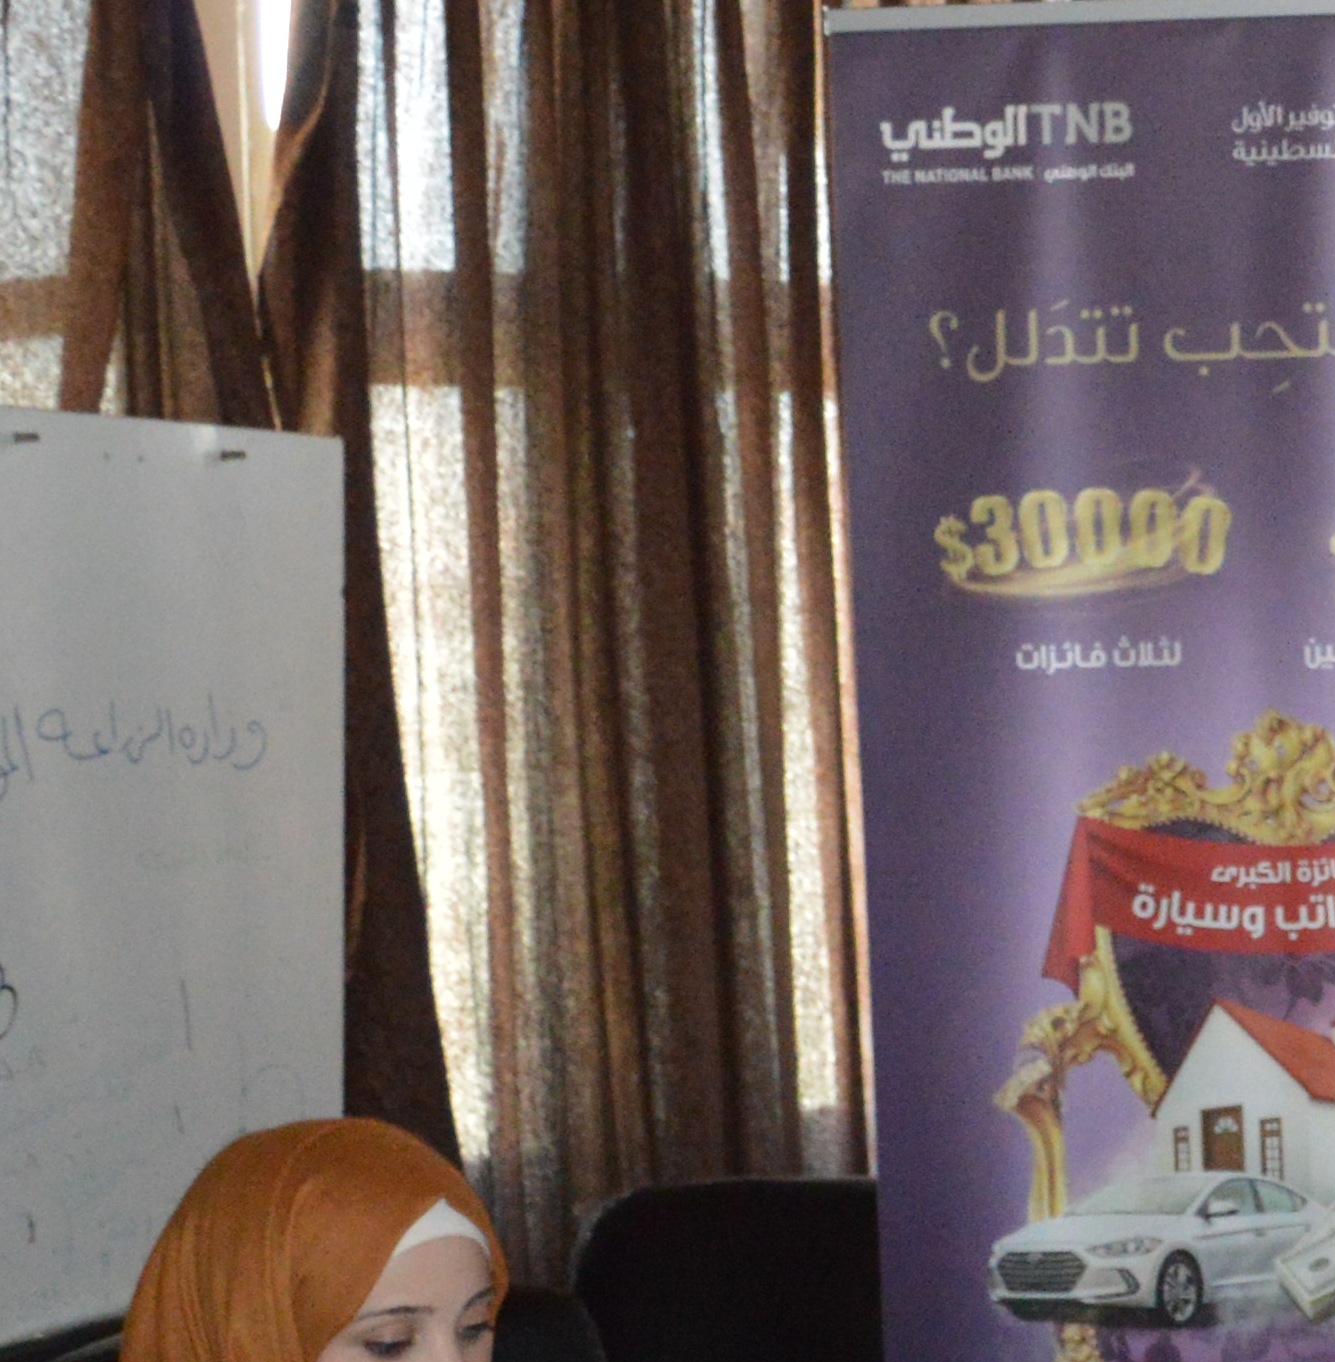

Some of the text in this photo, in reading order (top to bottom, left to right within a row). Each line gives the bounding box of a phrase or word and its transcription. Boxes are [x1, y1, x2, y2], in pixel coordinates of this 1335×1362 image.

[879, 106, 1028, 162] الوطني
[1030, 102, 1133, 145] TNB
[1231, 101, 1283, 133] الأول
[883, 165, 1034, 184] THE NATIONAL BANK
[933, 487, 1232, 579] $30000
[1015, 635, 1182, 676] لثلاث فائزات
[1210, 860, 1292, 889] الكبرى
[1131, 883, 1265, 939] وسيارة
